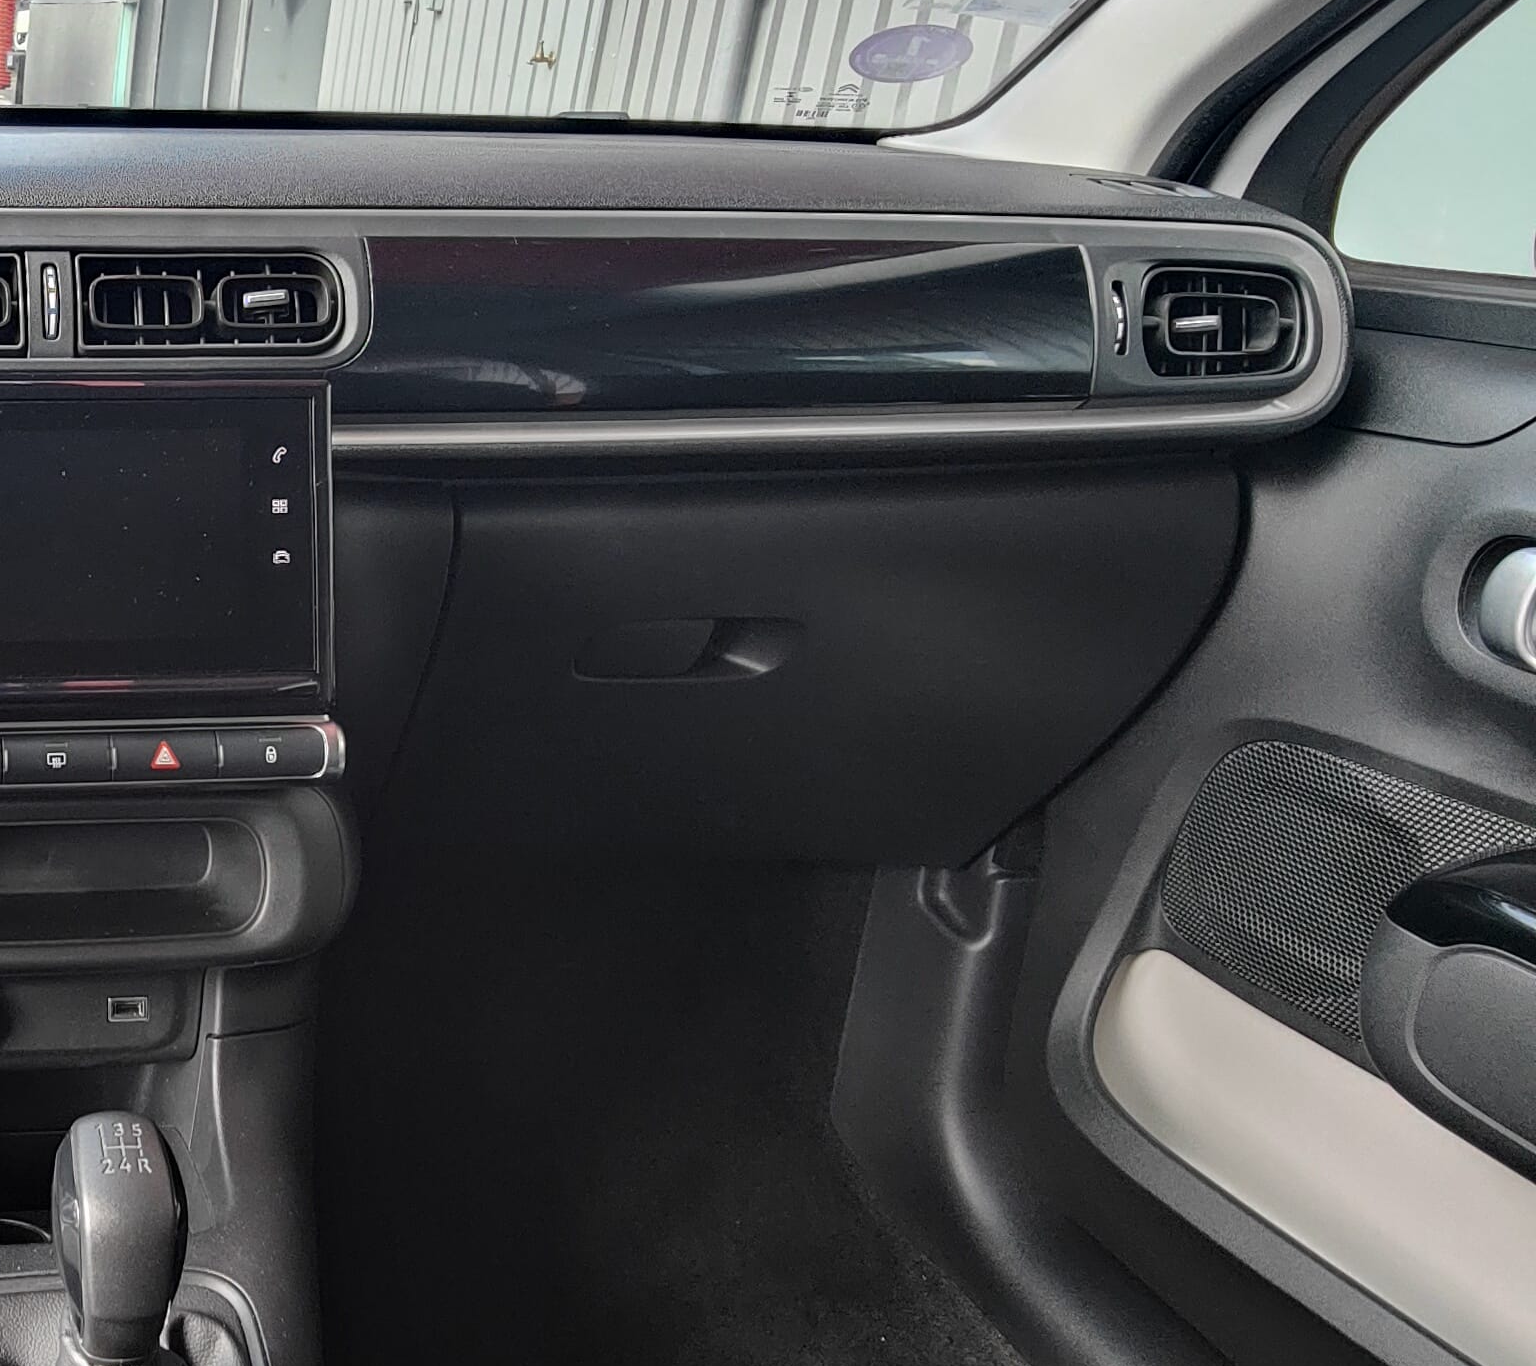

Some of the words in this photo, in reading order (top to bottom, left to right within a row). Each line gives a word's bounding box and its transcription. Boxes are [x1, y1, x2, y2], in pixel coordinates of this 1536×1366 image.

[113, 1122, 124, 1137] 3
[131, 1123, 143, 1136] 5
[102, 1158, 115, 1175] 2
[119, 1156, 132, 1174] 4
[137, 1158, 153, 1174] R
